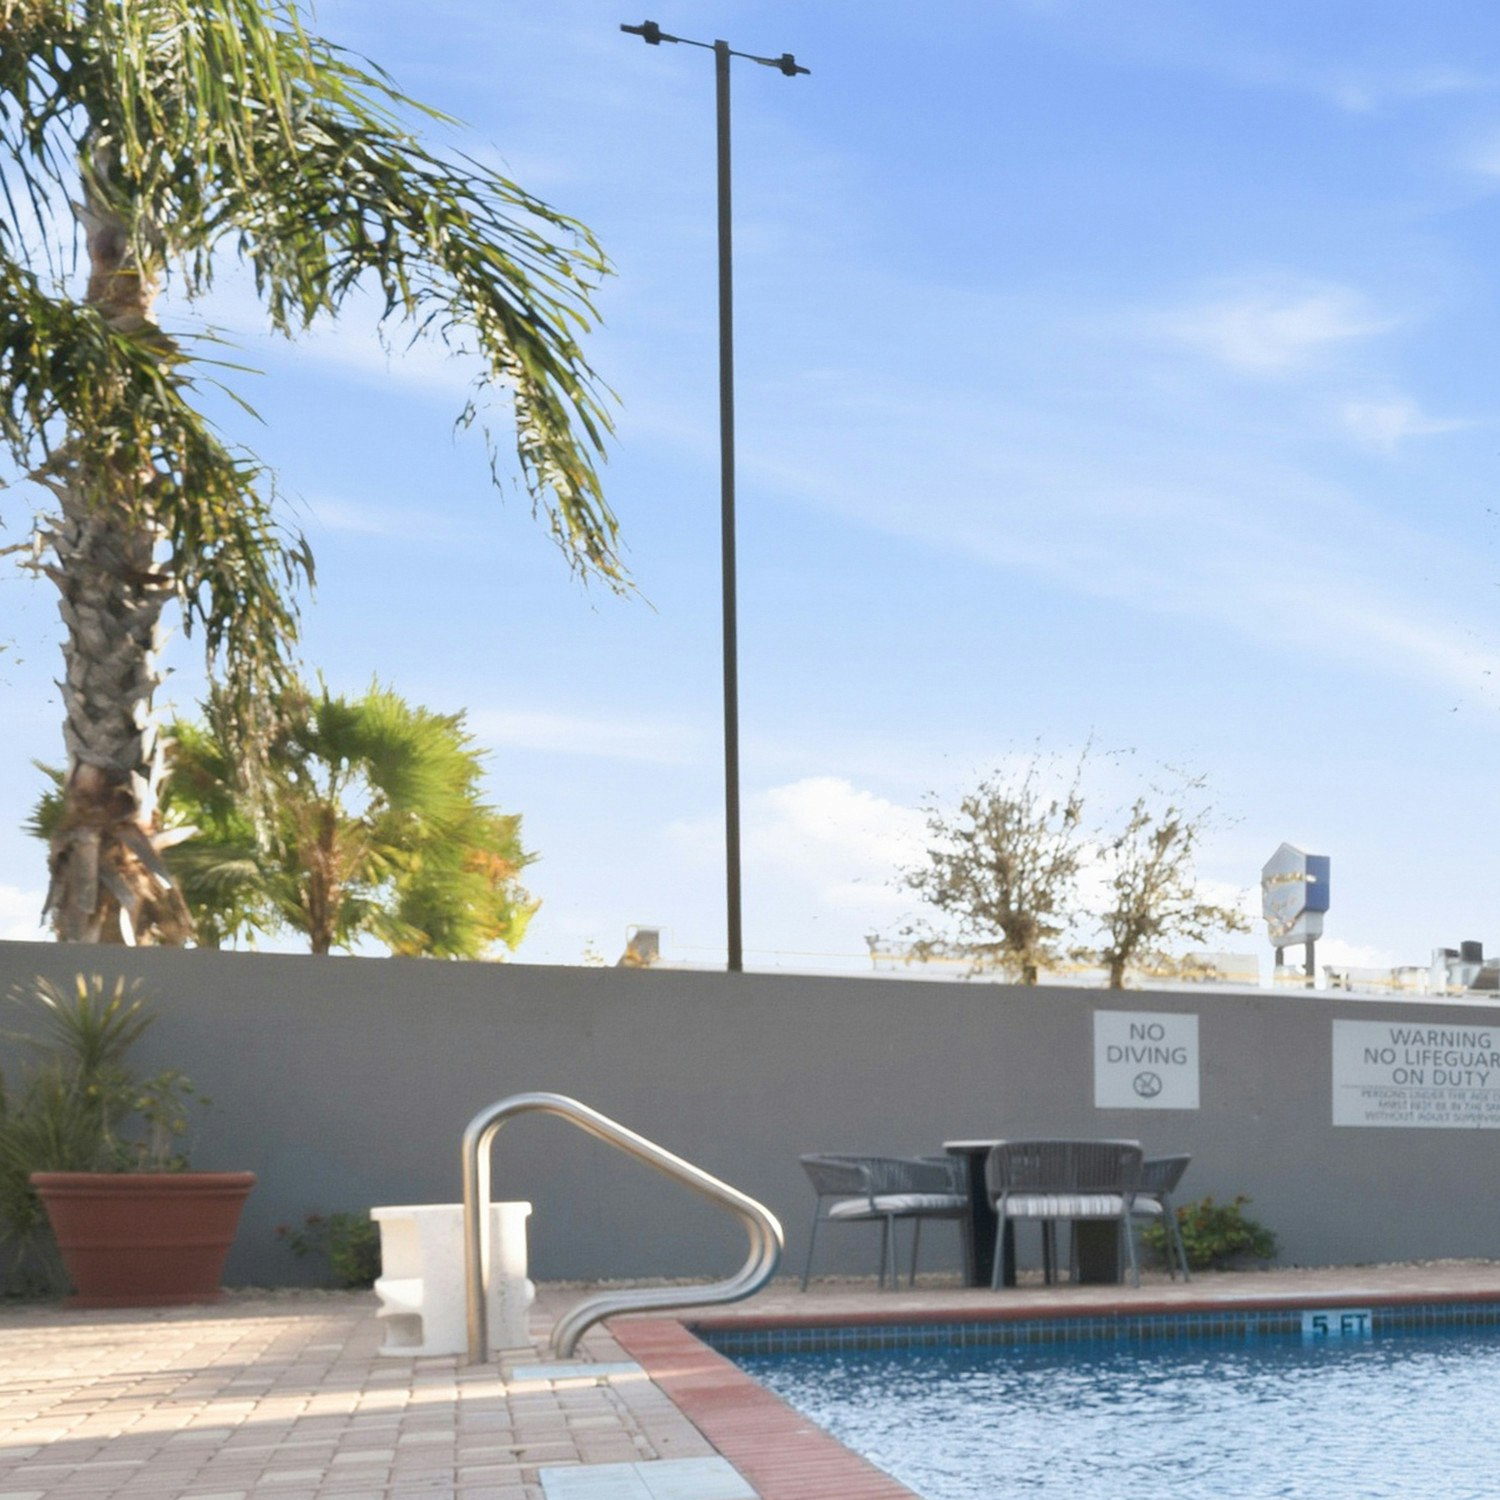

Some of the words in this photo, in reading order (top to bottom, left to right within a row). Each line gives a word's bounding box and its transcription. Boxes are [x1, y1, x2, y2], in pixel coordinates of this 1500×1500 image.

[1130, 1023, 1165, 1042] NO
[1390, 1028, 1492, 1049] WARNING
[1106, 1044, 1188, 1065] DIVING
[1364, 1048, 1396, 1065] NO
[1392, 1068, 1424, 1085] ON
[1433, 1069, 1490, 1087] DUTY
[1312, 1315, 1328, 1336] 5
[1341, 1314, 1368, 1335] FT
